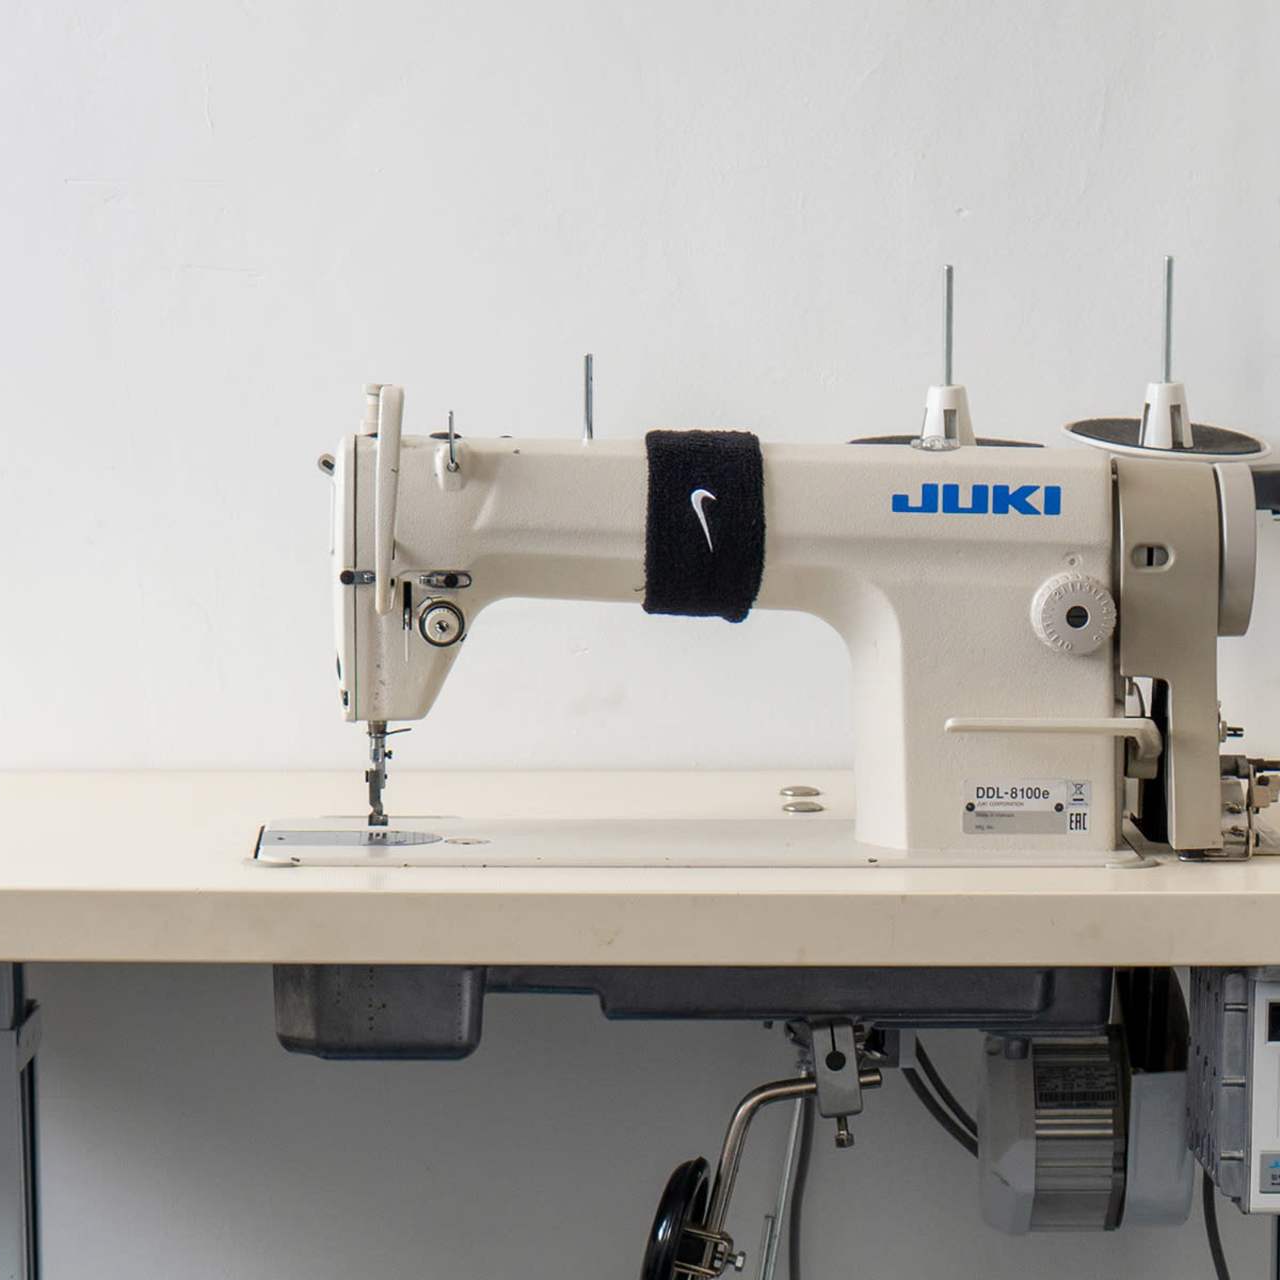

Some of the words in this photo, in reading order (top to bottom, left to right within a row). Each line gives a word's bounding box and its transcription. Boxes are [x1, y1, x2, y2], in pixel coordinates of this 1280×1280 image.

[892, 483, 1061, 515] JUKI
[976, 787, 1050, 799] DDL-8100e
[1069, 813, 1087, 830] EAC
